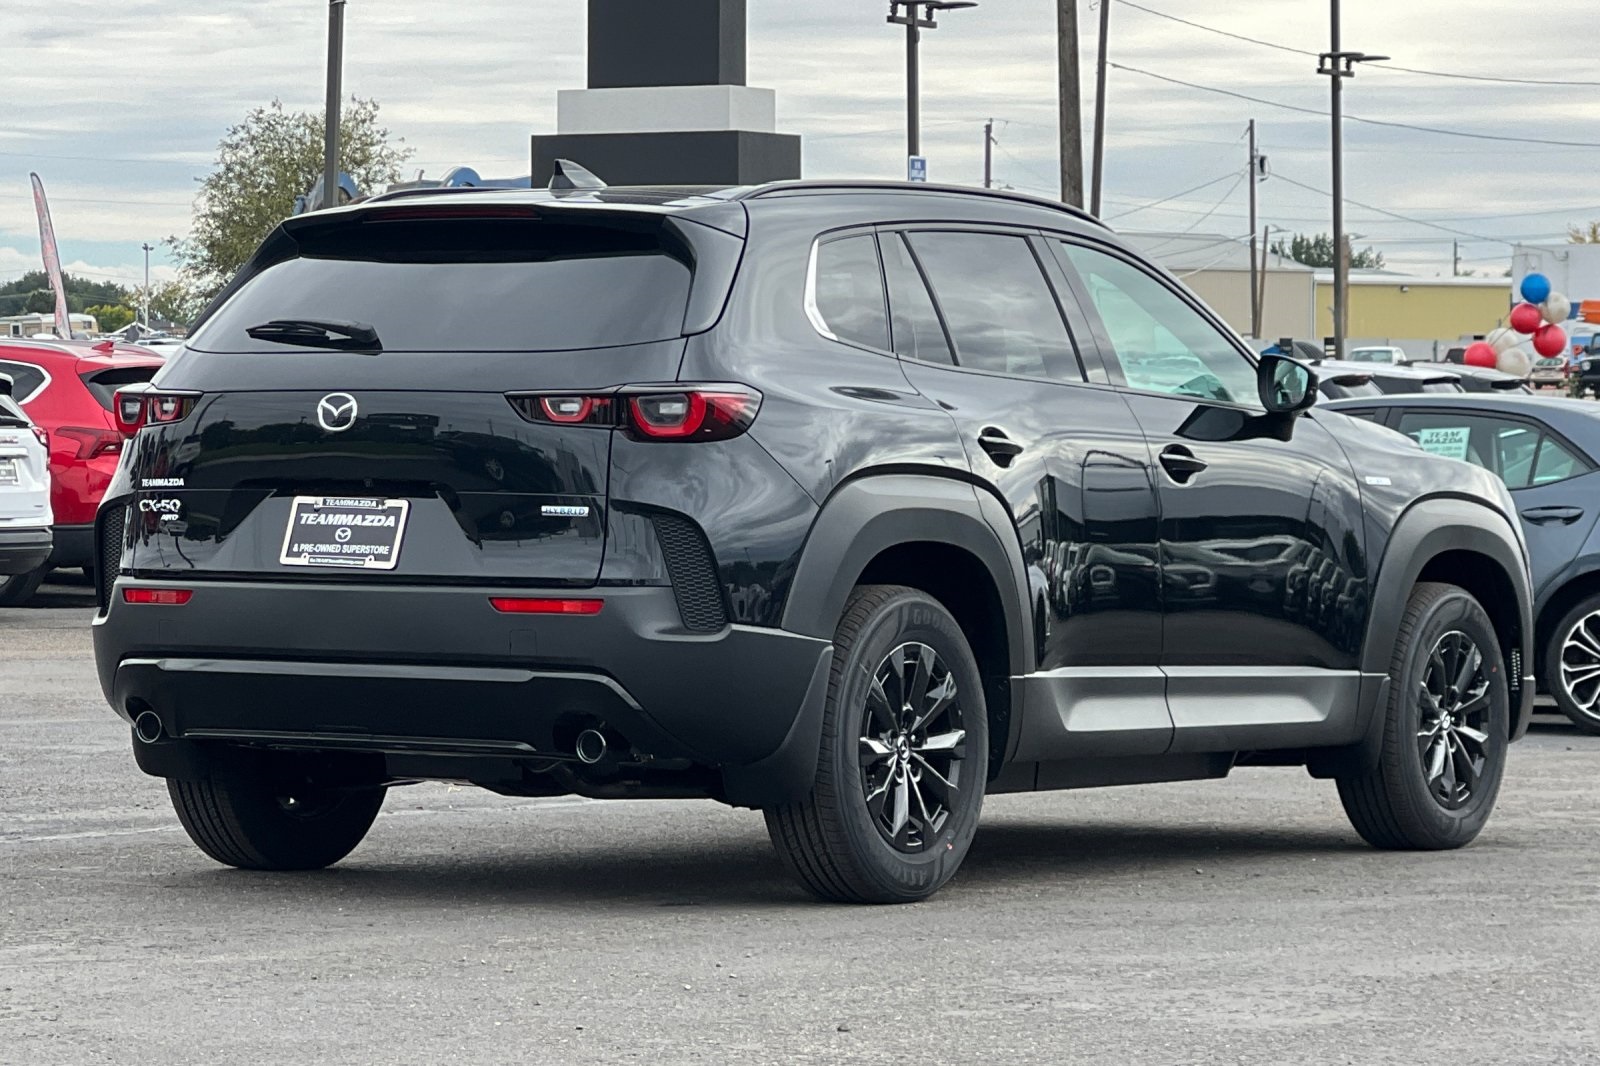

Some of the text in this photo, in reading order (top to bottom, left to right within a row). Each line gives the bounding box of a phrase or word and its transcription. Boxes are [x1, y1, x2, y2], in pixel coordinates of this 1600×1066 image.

[141, 478, 184, 487] TEAMMAZDA
[139, 499, 181, 512] CX-50
[325, 499, 378, 508] TEAMMAZDA
[544, 506, 586, 516] HYBRID
[300, 513, 396, 527] TEAMMAZDA
[292, 543, 390, 555] & PRE-OWNED SUPERSTORE
